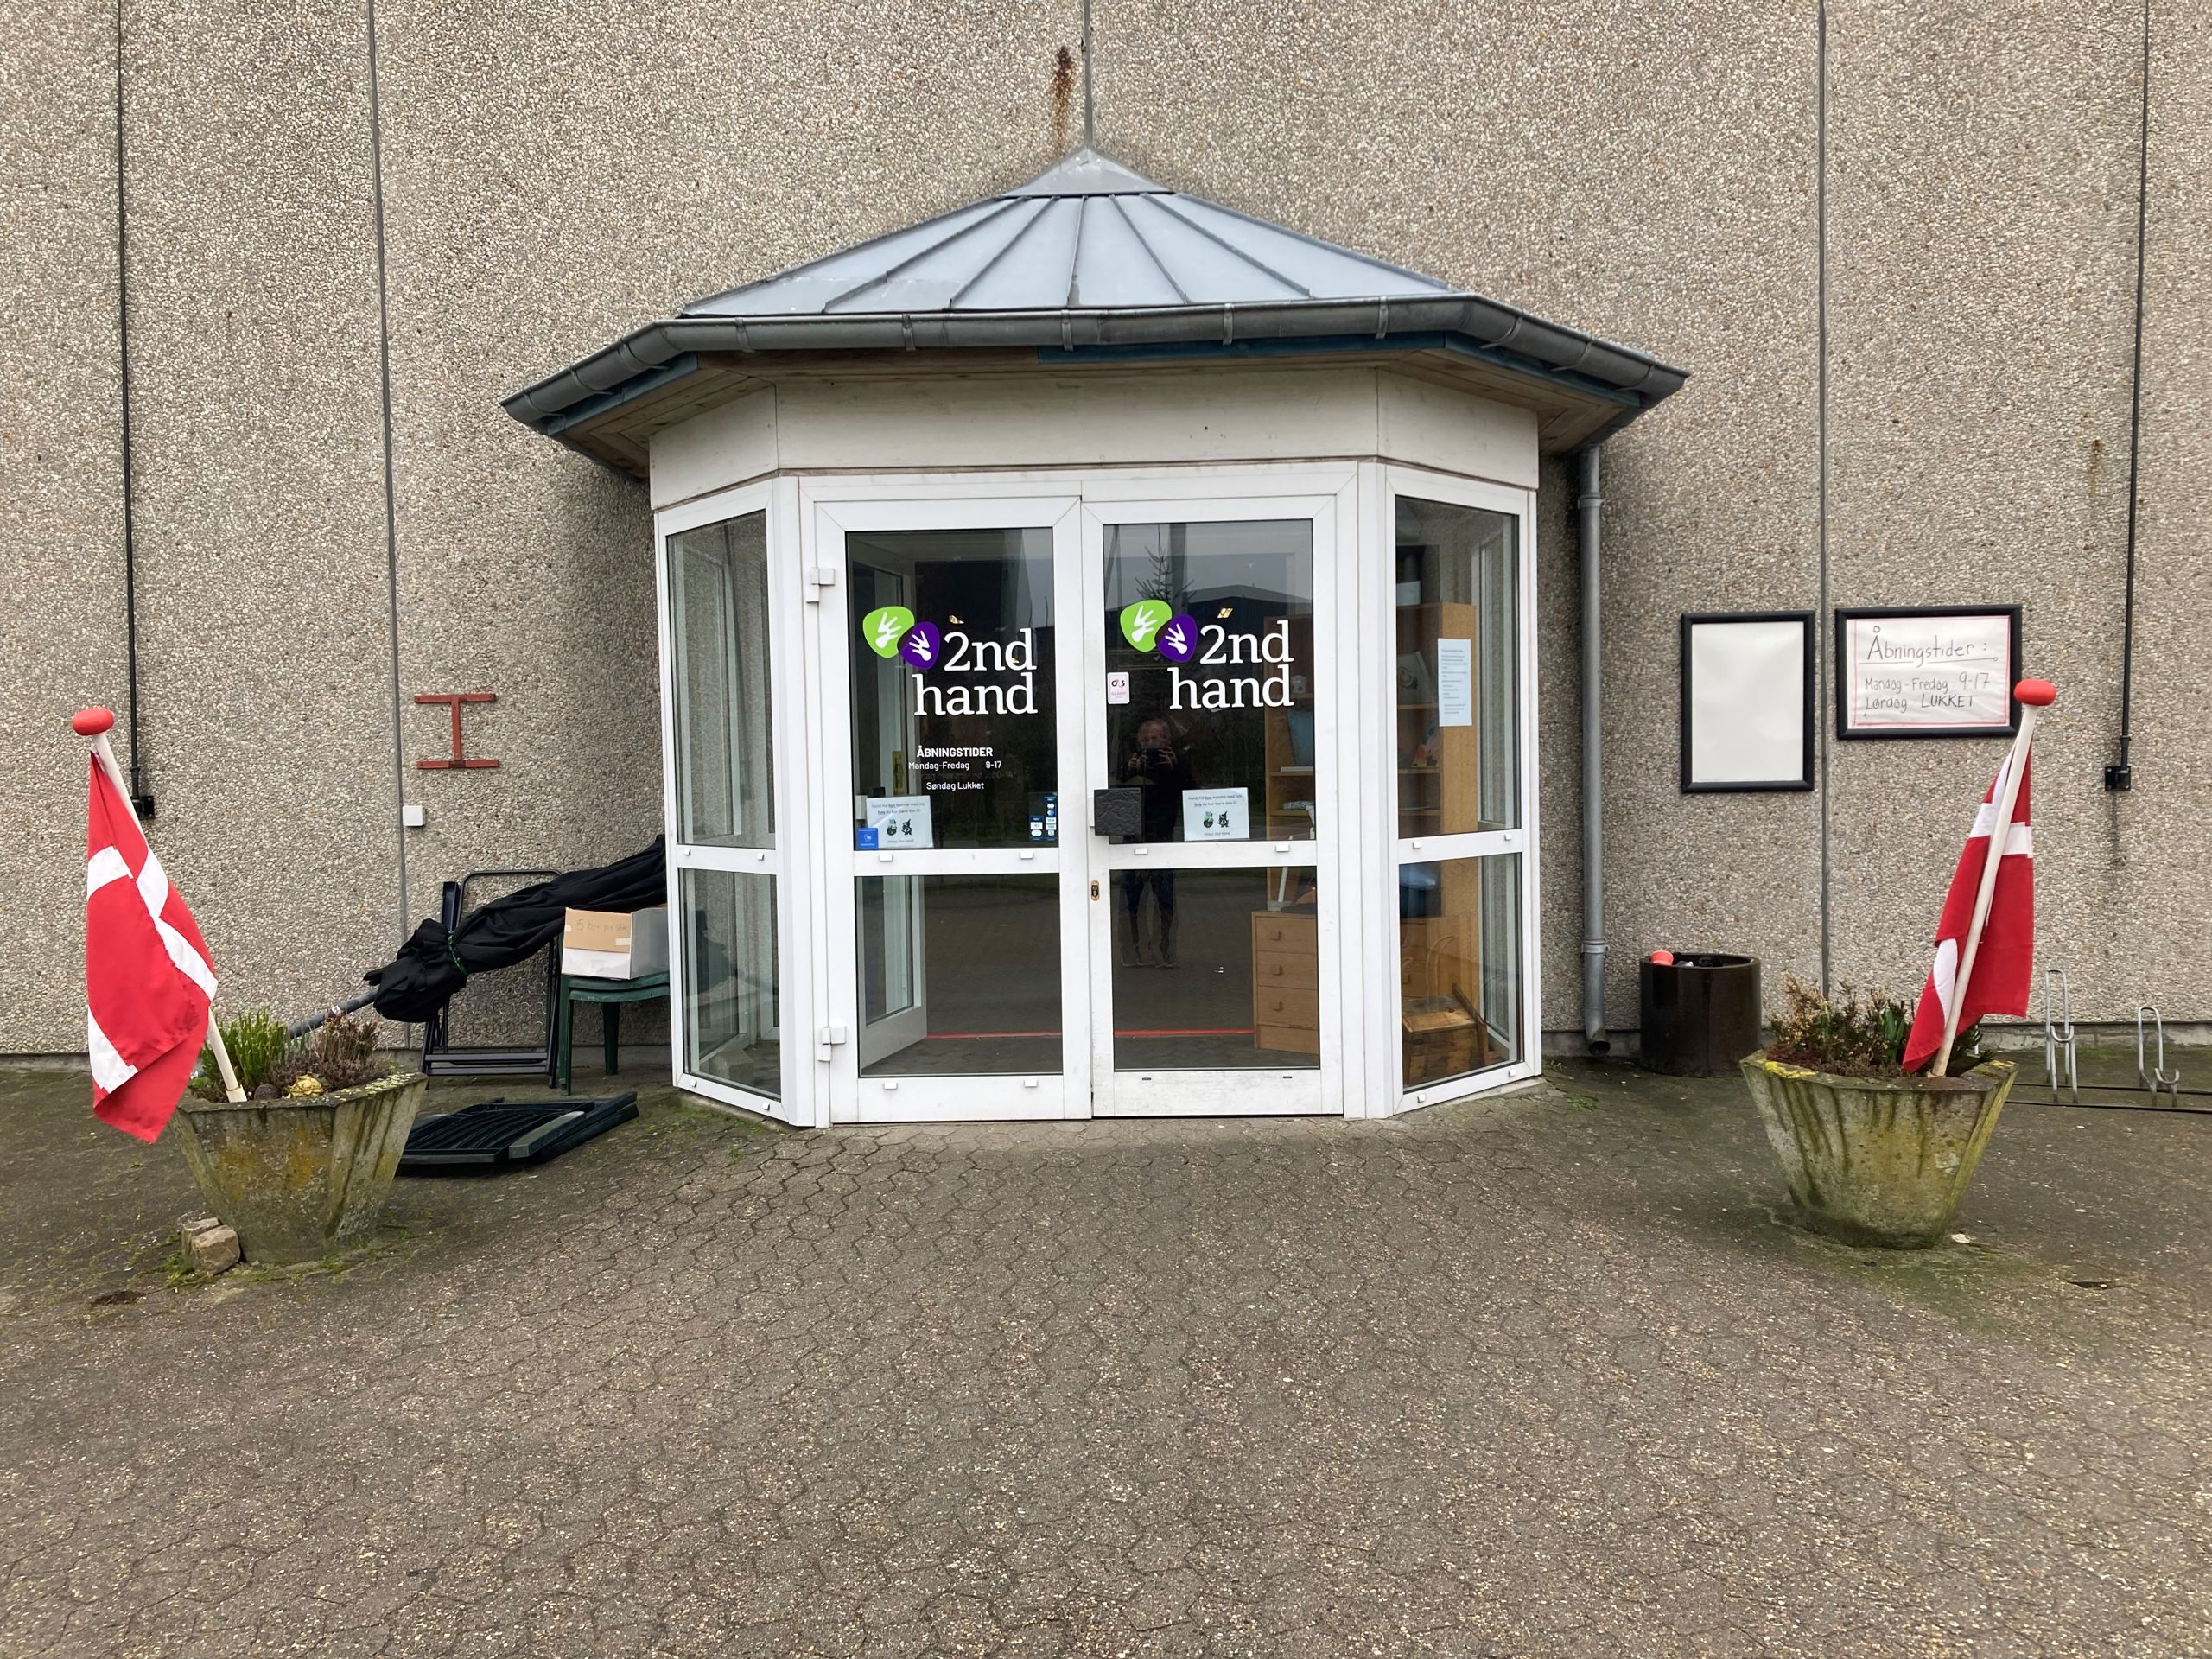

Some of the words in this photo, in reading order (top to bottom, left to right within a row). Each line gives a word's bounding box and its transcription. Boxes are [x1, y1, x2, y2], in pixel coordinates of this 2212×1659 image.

[944, 627, 1037, 671] 2nd
[1199, 620, 1294, 664] 2nd
[912, 671, 1038, 715] hand
[1166, 664, 1294, 709] hand
[1866, 697, 1908, 713] Lørdag
[1921, 694, 1978, 708] LUKKET
[908, 761, 970, 772] Mandag-Fredag
[986, 760, 1002, 769] 9-17
[917, 744, 994, 758] ÅBNINGSTIDER
[926, 781, 957, 791] Søndag
[957, 781, 985, 790] Lukket
